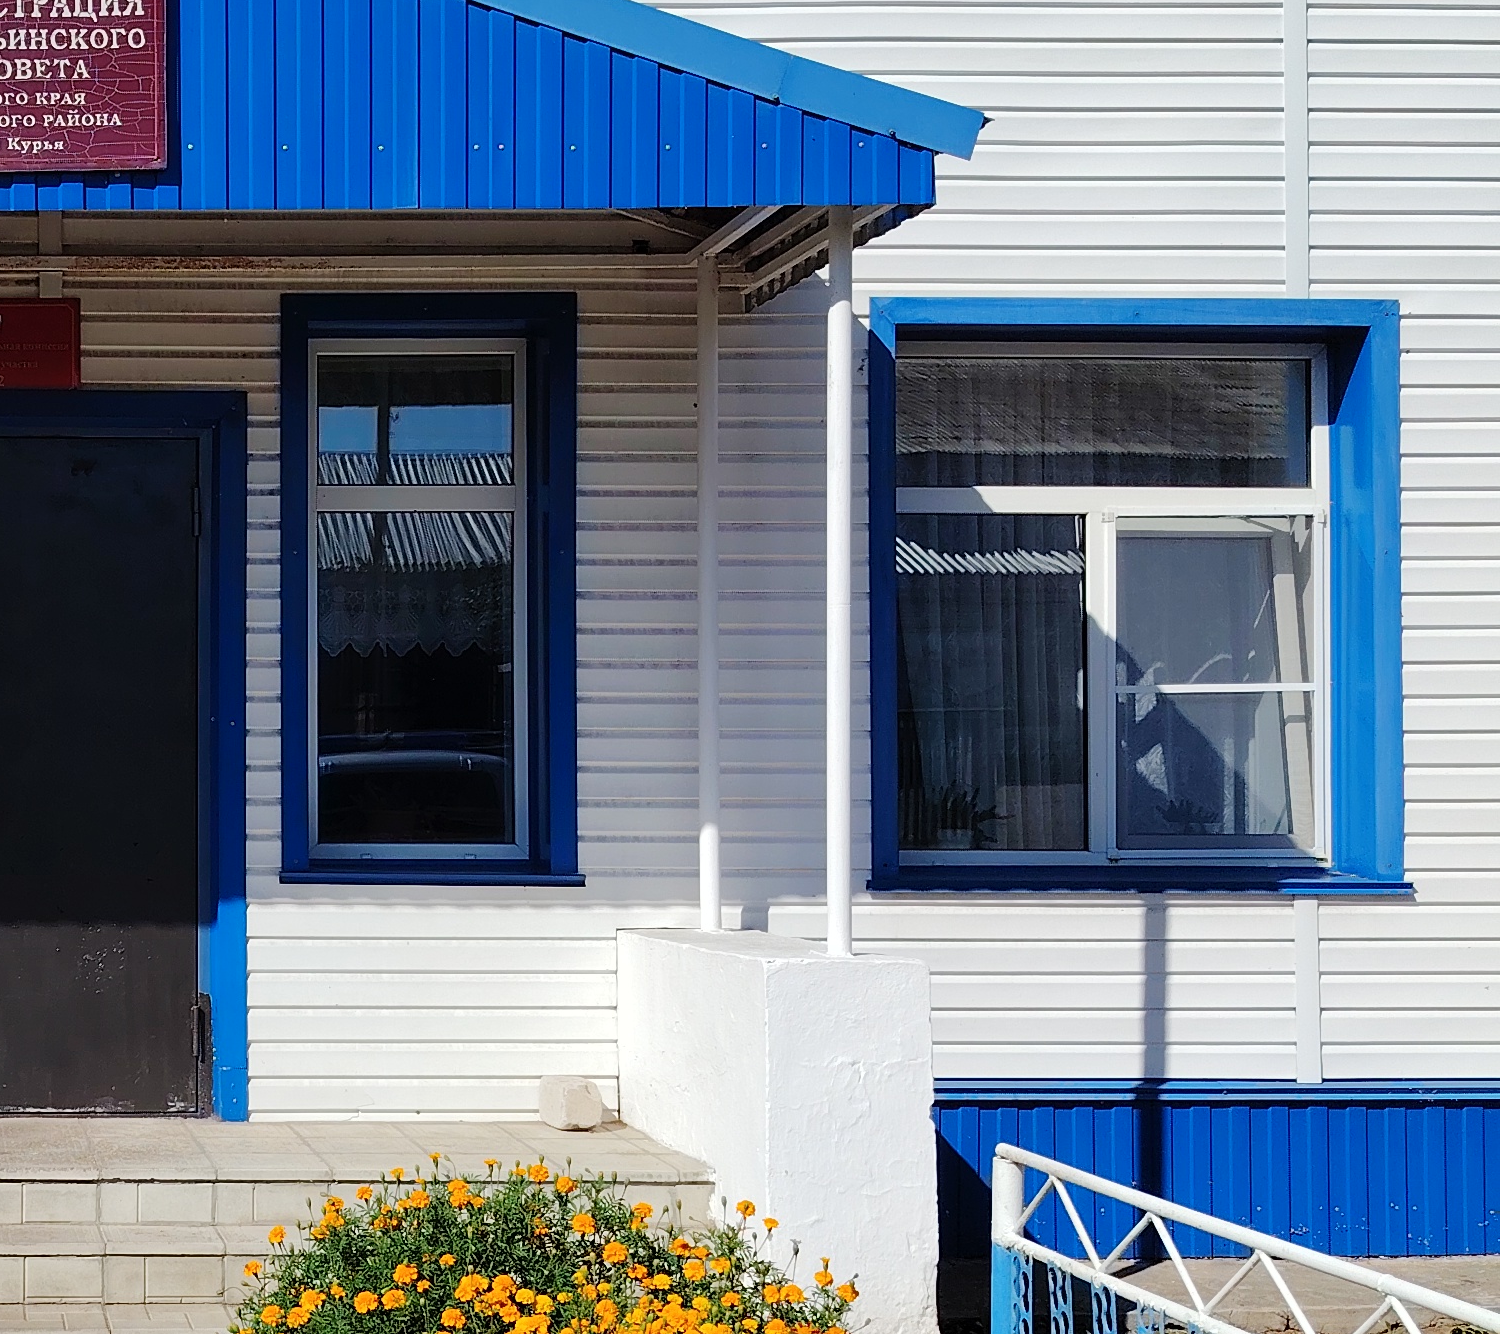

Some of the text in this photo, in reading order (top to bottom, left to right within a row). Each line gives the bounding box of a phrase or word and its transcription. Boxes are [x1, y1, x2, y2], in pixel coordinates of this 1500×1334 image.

[35, 92, 87, 106] КРАЯ
[43, 109, 123, 127] РАЙОНА
[6, 137, 64, 154] Курья
[22, 342, 70, 352] комиссия
[0, 360, 39, 371] участка
